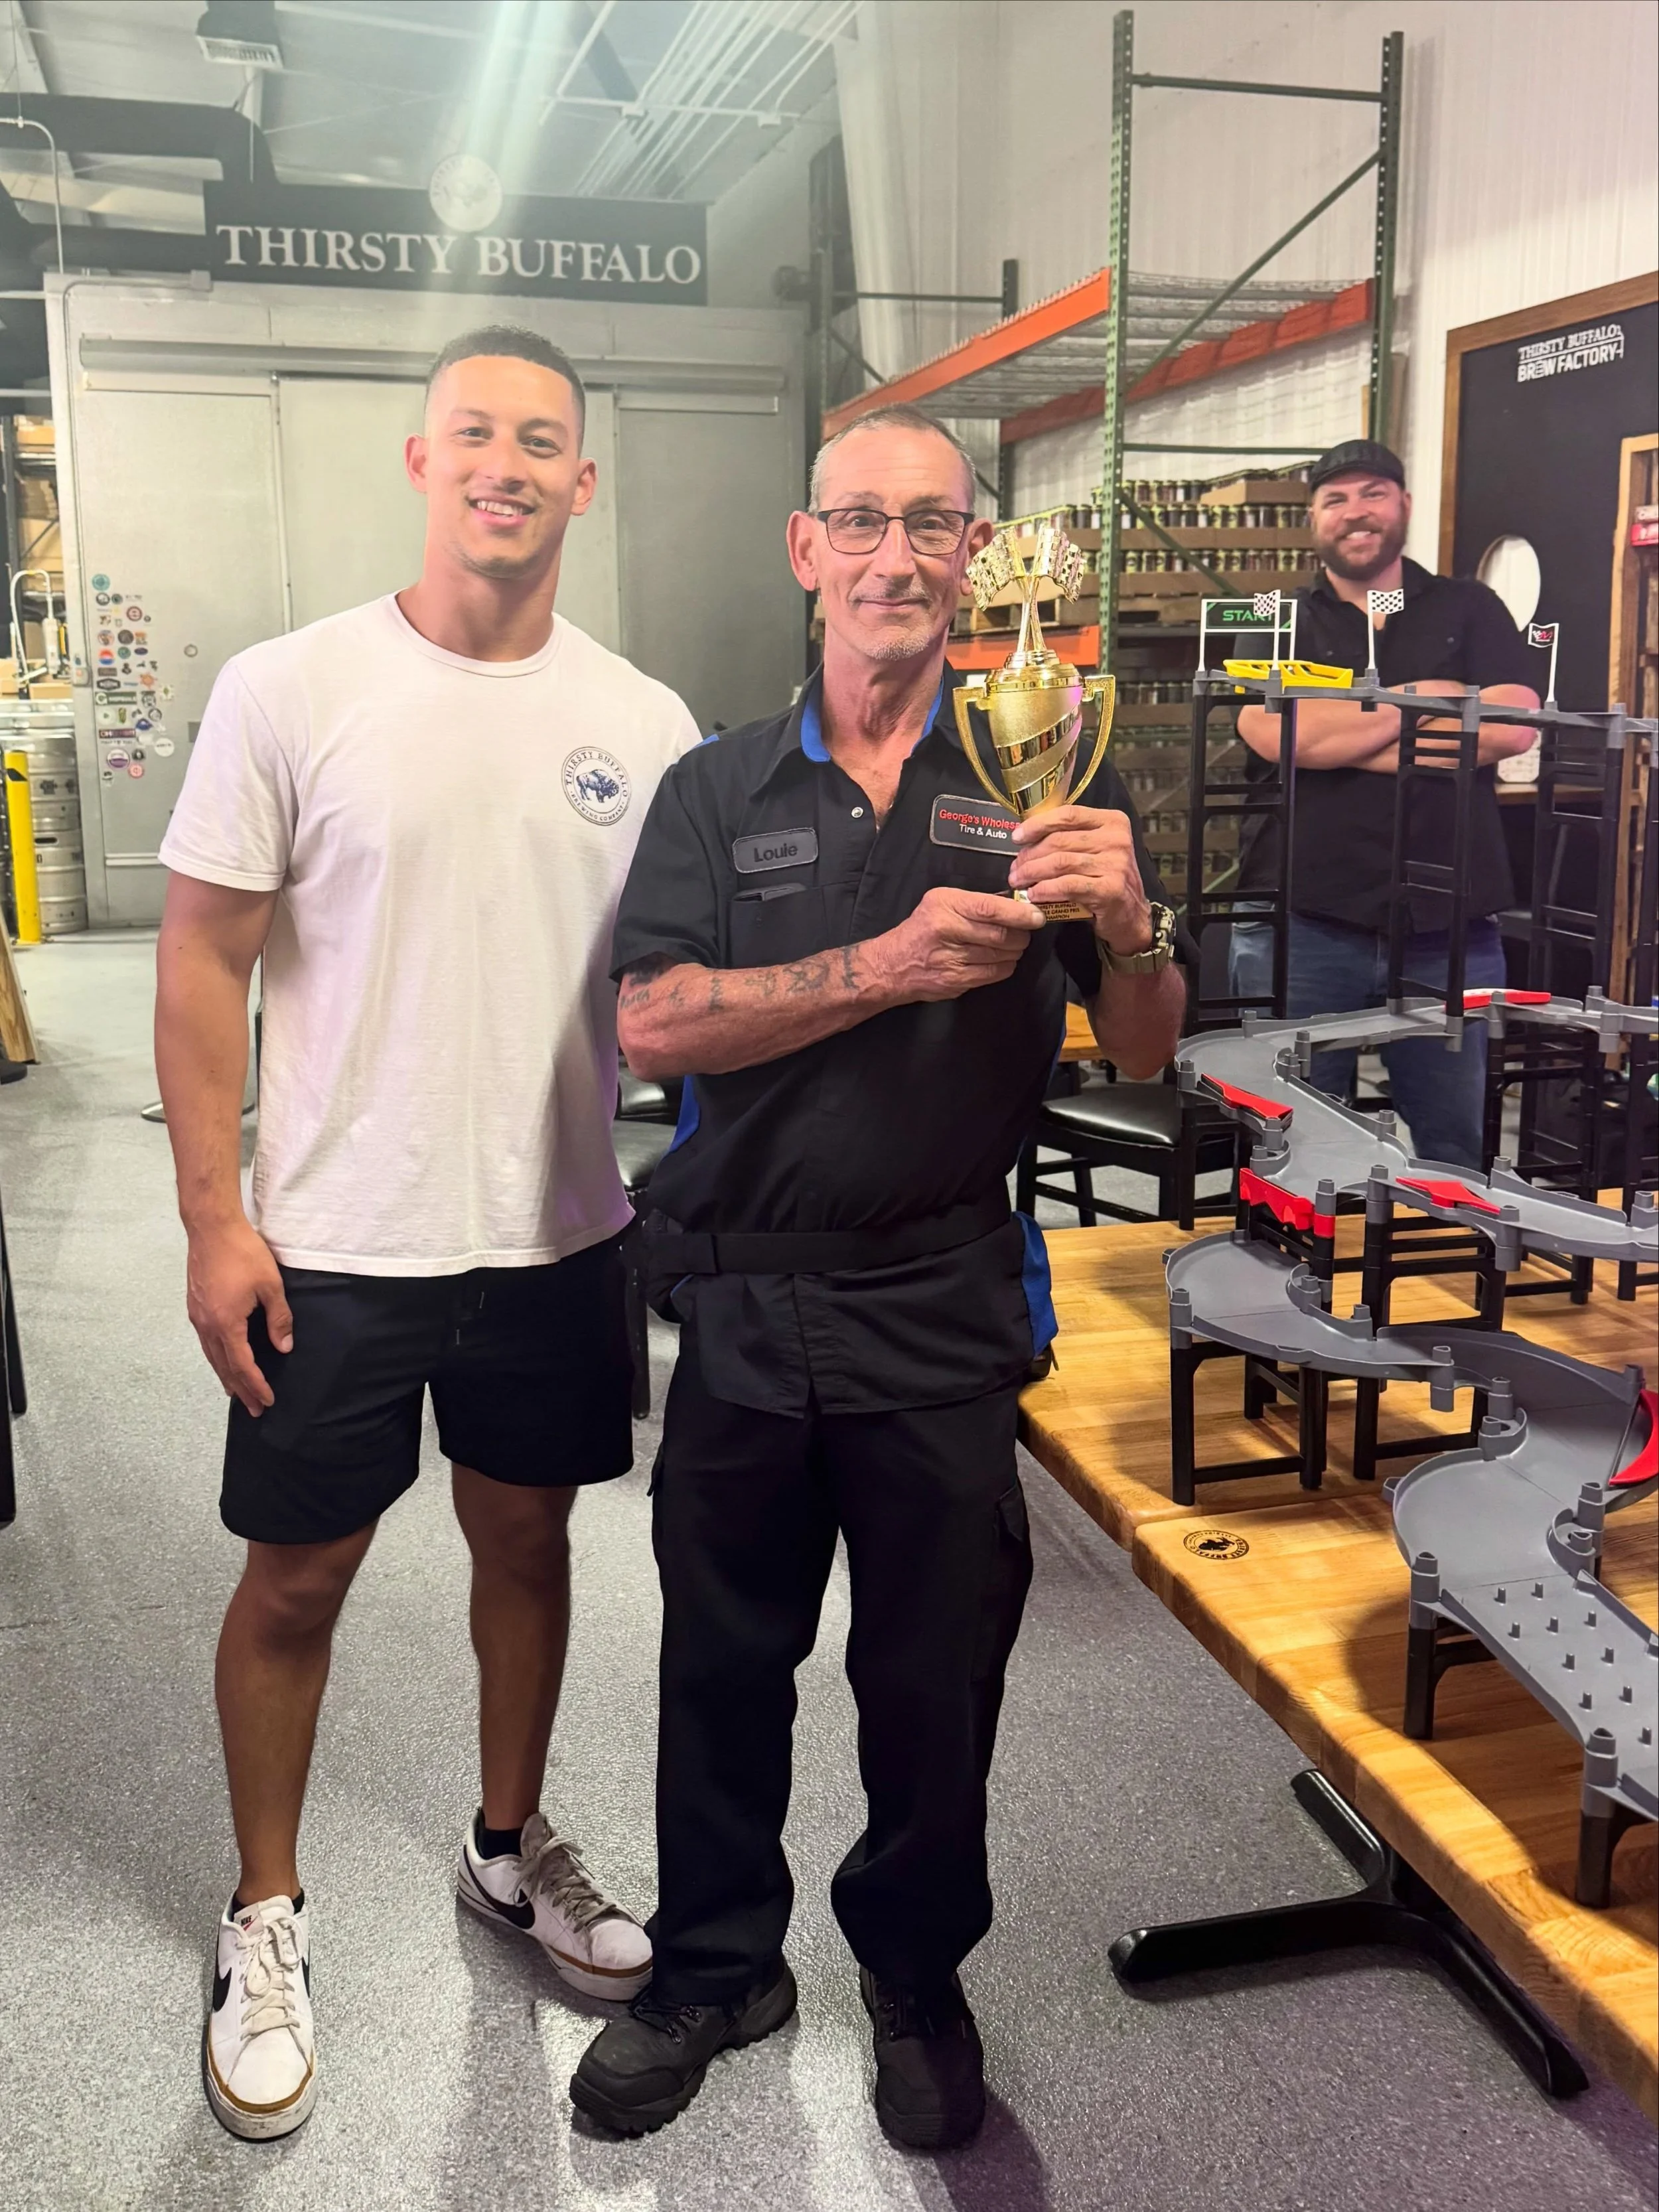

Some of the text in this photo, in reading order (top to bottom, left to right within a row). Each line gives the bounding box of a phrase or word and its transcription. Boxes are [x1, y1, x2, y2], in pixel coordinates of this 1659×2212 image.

[216, 224, 701, 285] THIRSTY BUFFALO
[1518, 324, 1618, 360] THIRSTY BUFFALO
[1517, 342, 1618, 382] BREW FACTORY
[565, 751, 628, 797] THIRSTY BUFFALO
[571, 794, 624, 821] BREWING COMPANY
[939, 809, 979, 824] George's
[960, 824, 1007, 840] Tire & Auto
[754, 843, 798, 862] Louie
